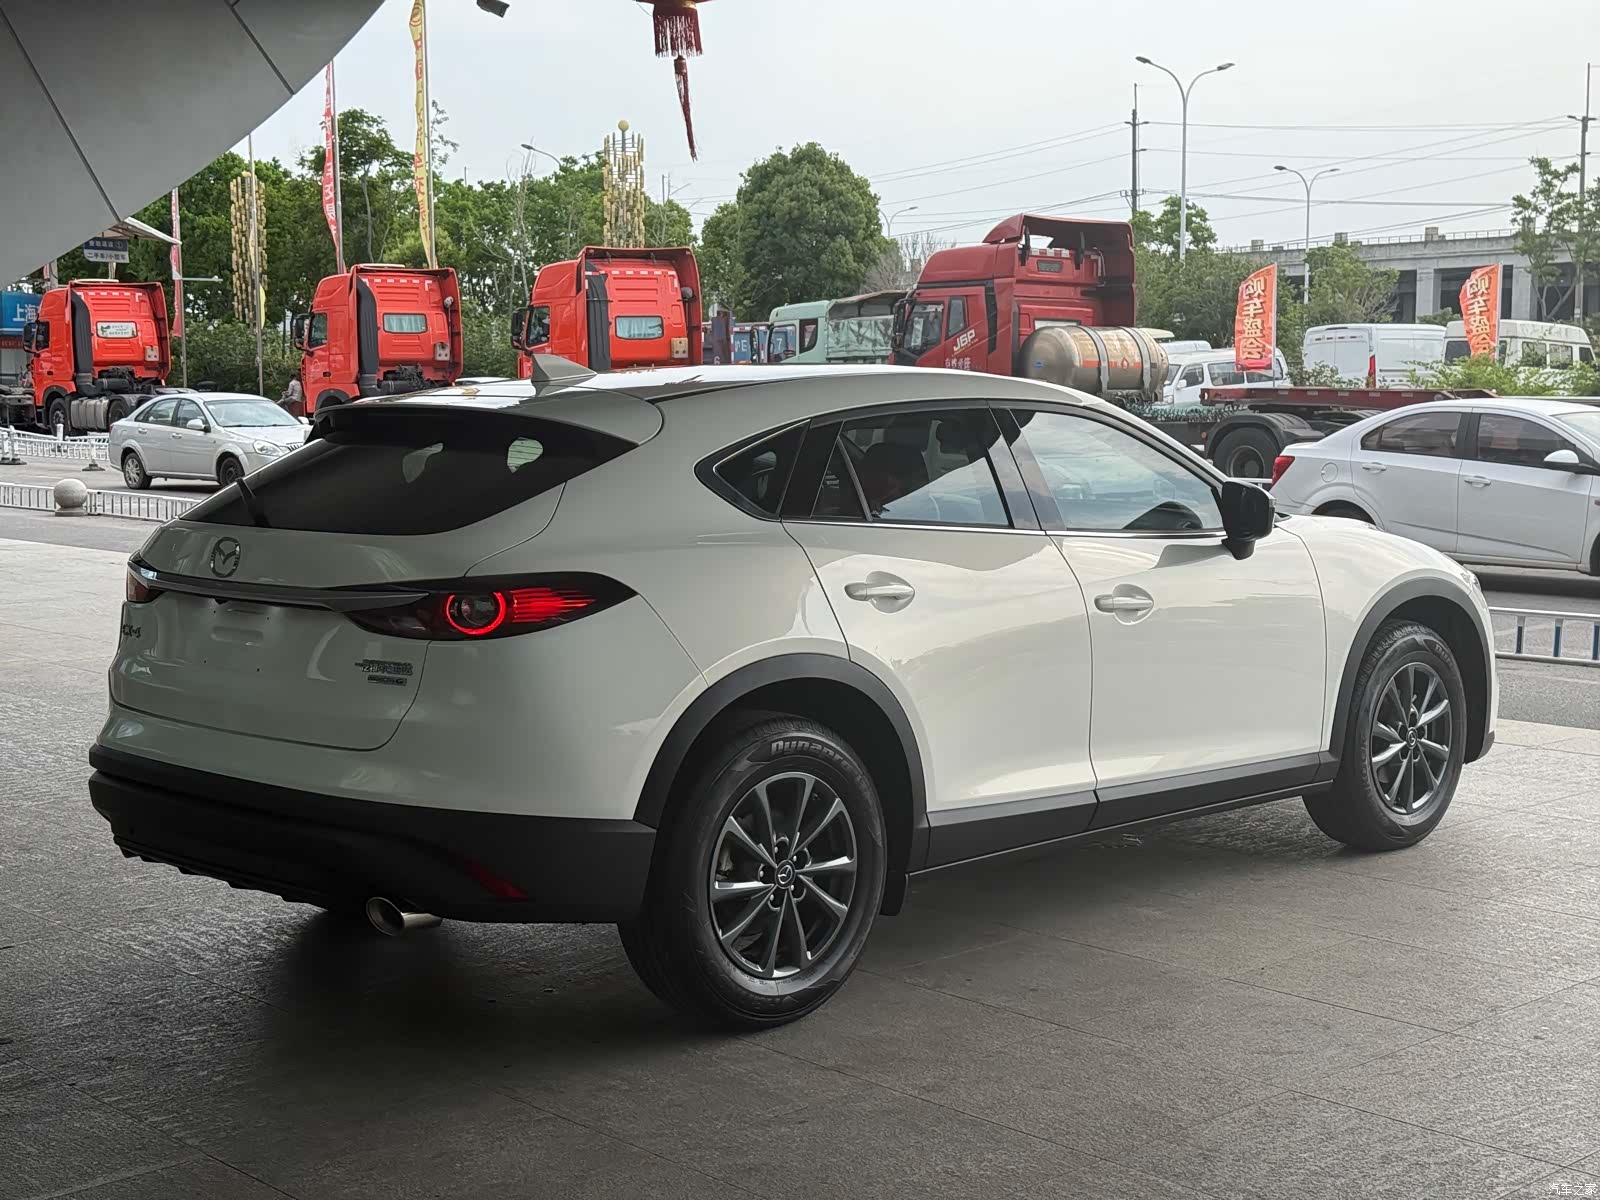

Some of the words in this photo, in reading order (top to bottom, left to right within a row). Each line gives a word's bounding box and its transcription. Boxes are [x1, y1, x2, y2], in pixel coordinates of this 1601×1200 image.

[12, 303, 39, 323] 上海
[953, 328, 976, 352] J6P
[771, 740, 853, 770] Dynapro
